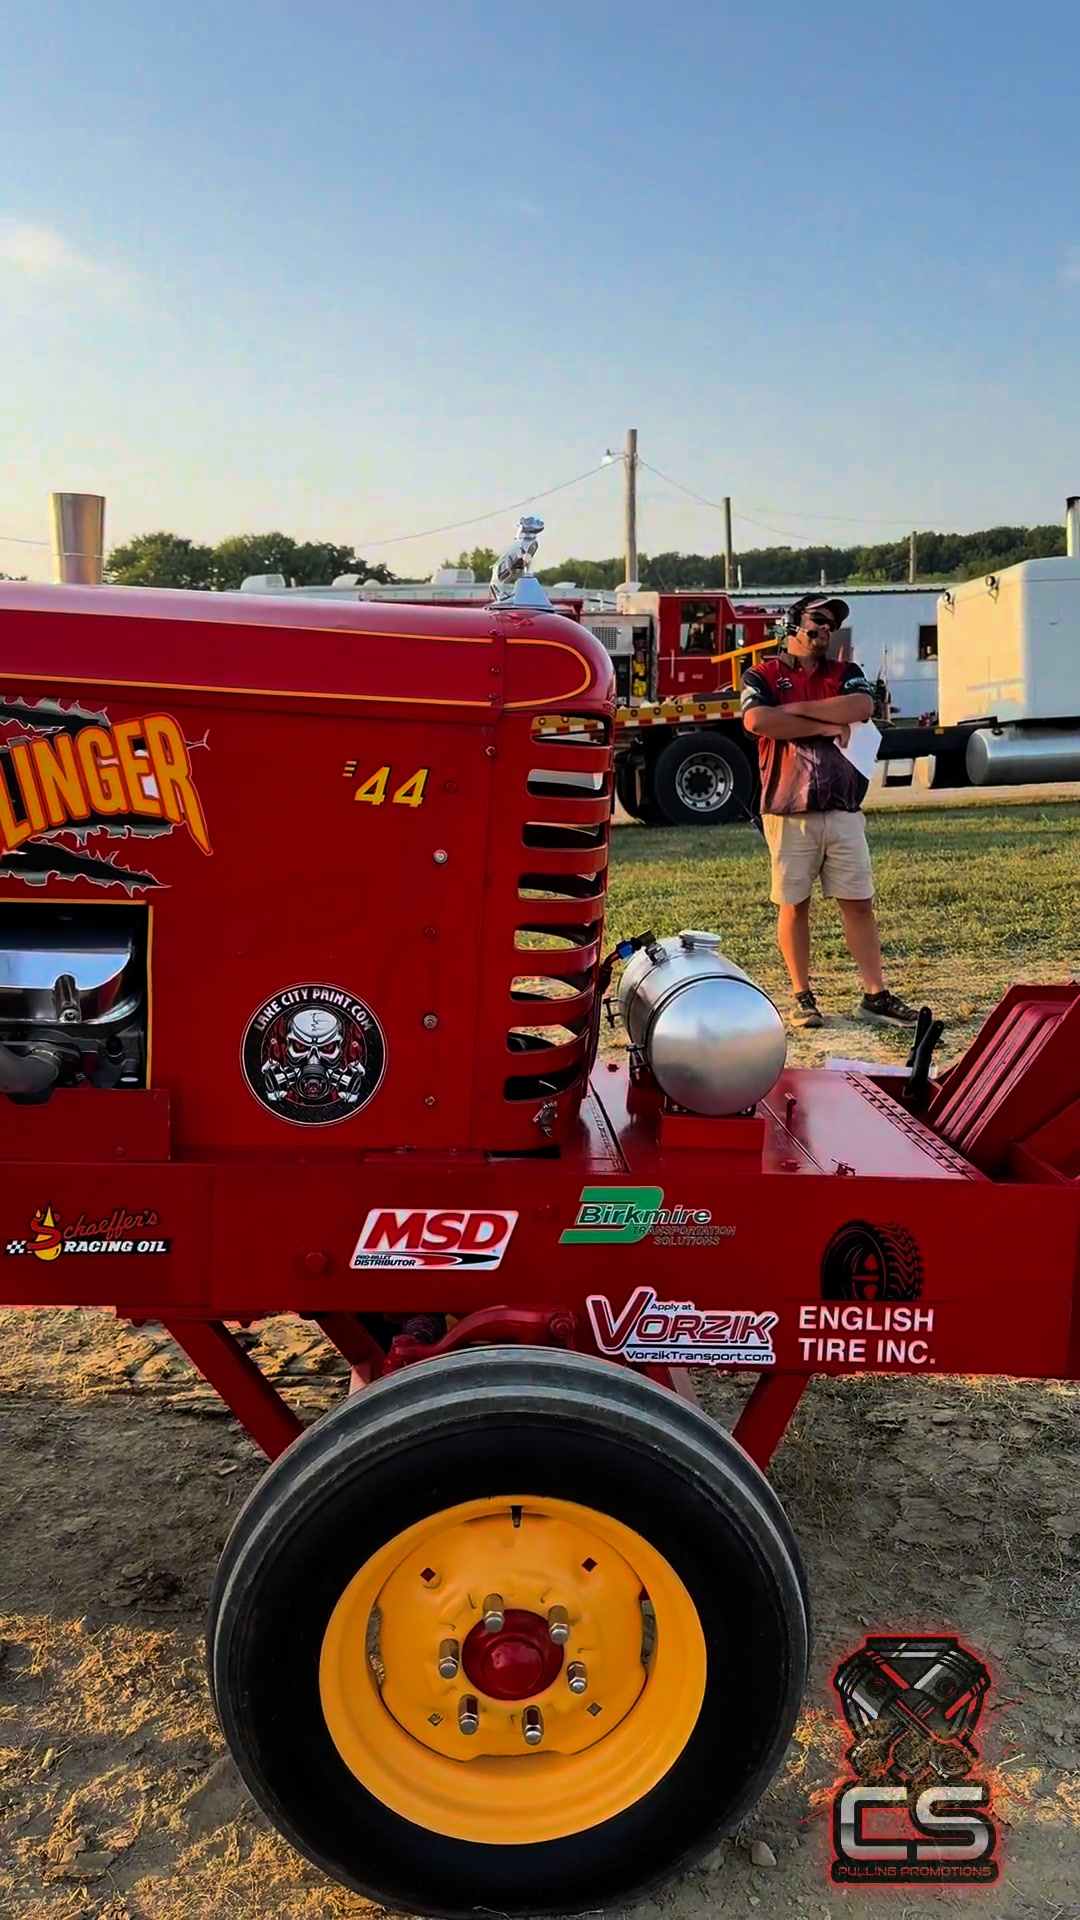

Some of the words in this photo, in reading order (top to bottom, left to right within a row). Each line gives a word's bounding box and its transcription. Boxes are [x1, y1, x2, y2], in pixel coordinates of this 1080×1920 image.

[353, 766, 430, 808] 44
[254, 1000, 282, 1032] LAKE
[281, 988, 309, 1006] CITY
[312, 987, 375, 1032] PAINT.COM
[576, 1203, 712, 1225] Birkmire
[27, 1209, 160, 1249] Schaeffer's
[362, 1212, 509, 1251] MSD
[633, 1226, 737, 1237] TRANSPORTATION
[653, 1236, 721, 1246] SOLUTIONS
[63, 1240, 134, 1252] RACING
[136, 1240, 167, 1252] OIL
[589, 1290, 777, 1351] VORZIK
[650, 1303, 680, 1311] Apply
[681, 1303, 693, 1311] at
[799, 1305, 935, 1332] ENGLISH
[625, 1350, 774, 1363] VorzikTransport.com
[797, 1337, 867, 1363] TIRE
[876, 1339, 937, 1364] INC.
